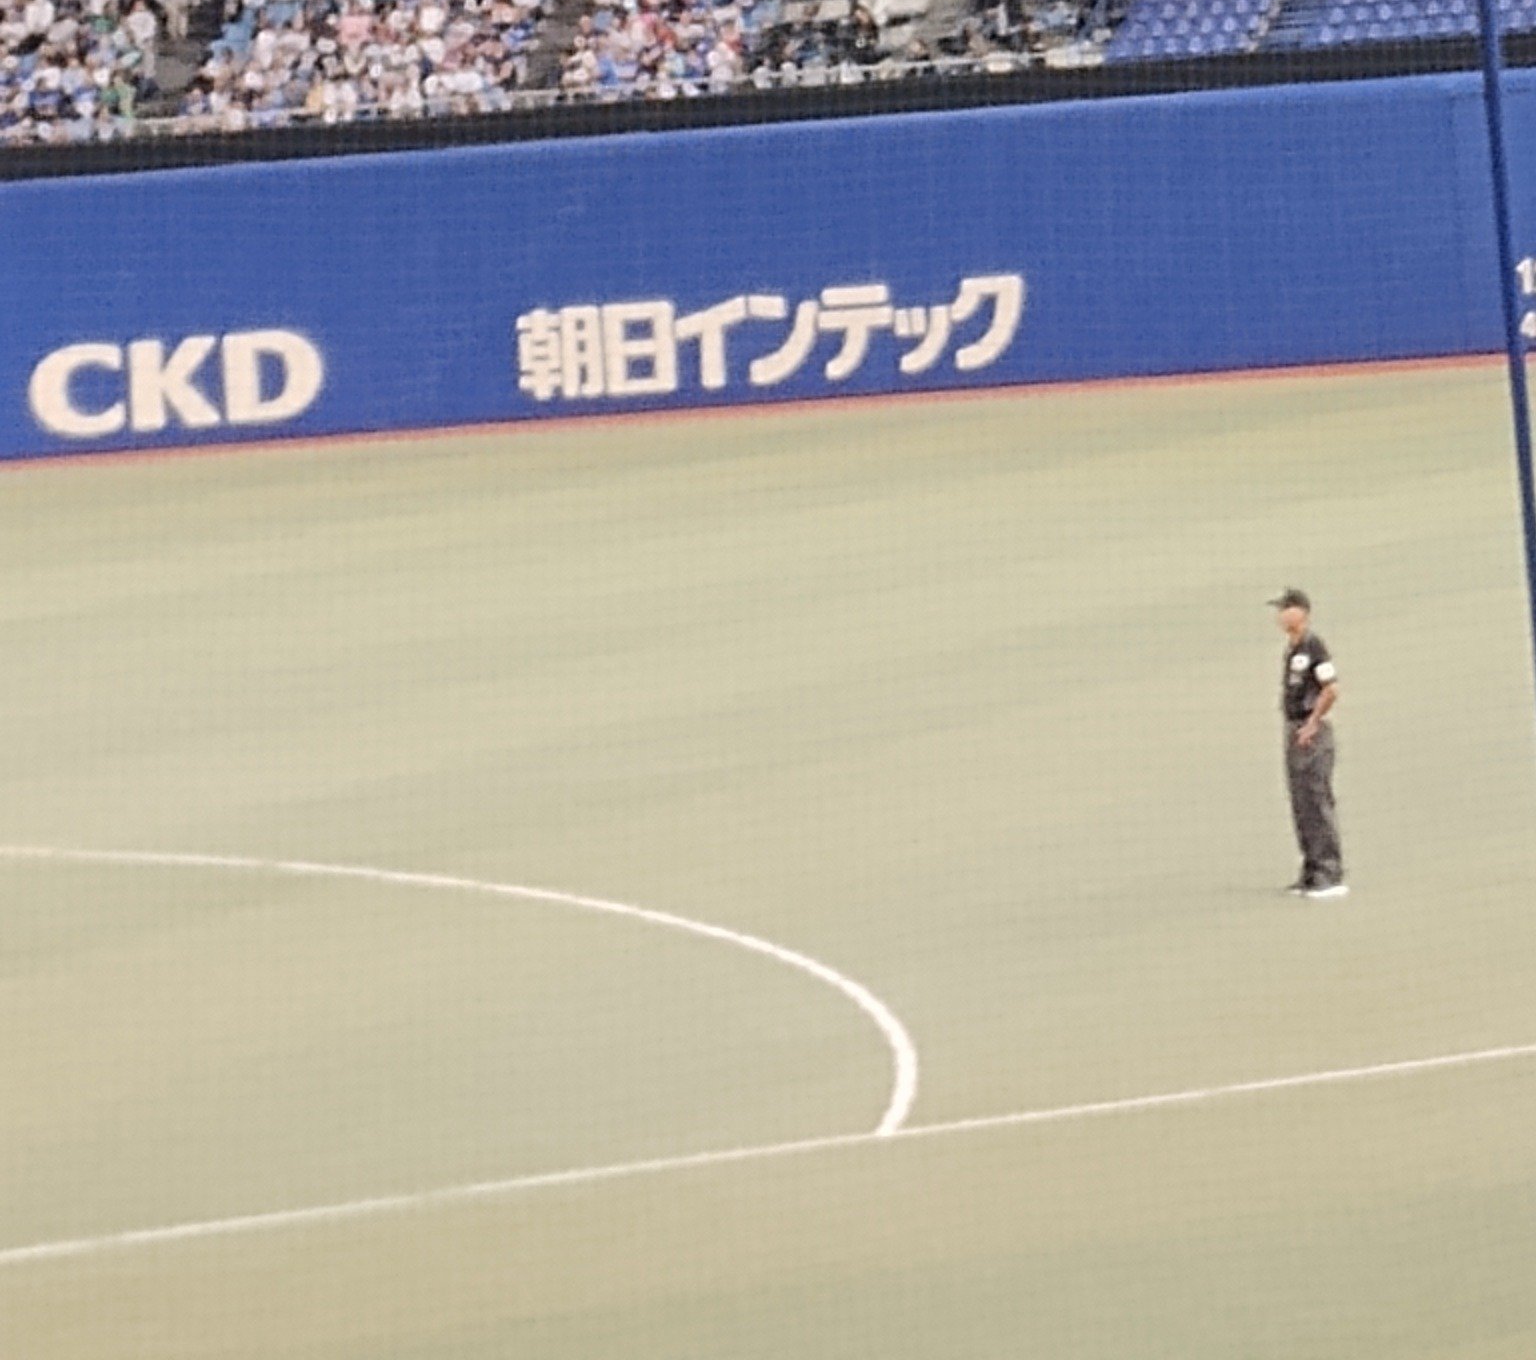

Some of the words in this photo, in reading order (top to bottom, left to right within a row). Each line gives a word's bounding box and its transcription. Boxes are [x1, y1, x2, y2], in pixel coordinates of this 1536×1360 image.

[27, 328, 326, 439] CKD
[516, 273, 1025, 401] 朝日インテック
